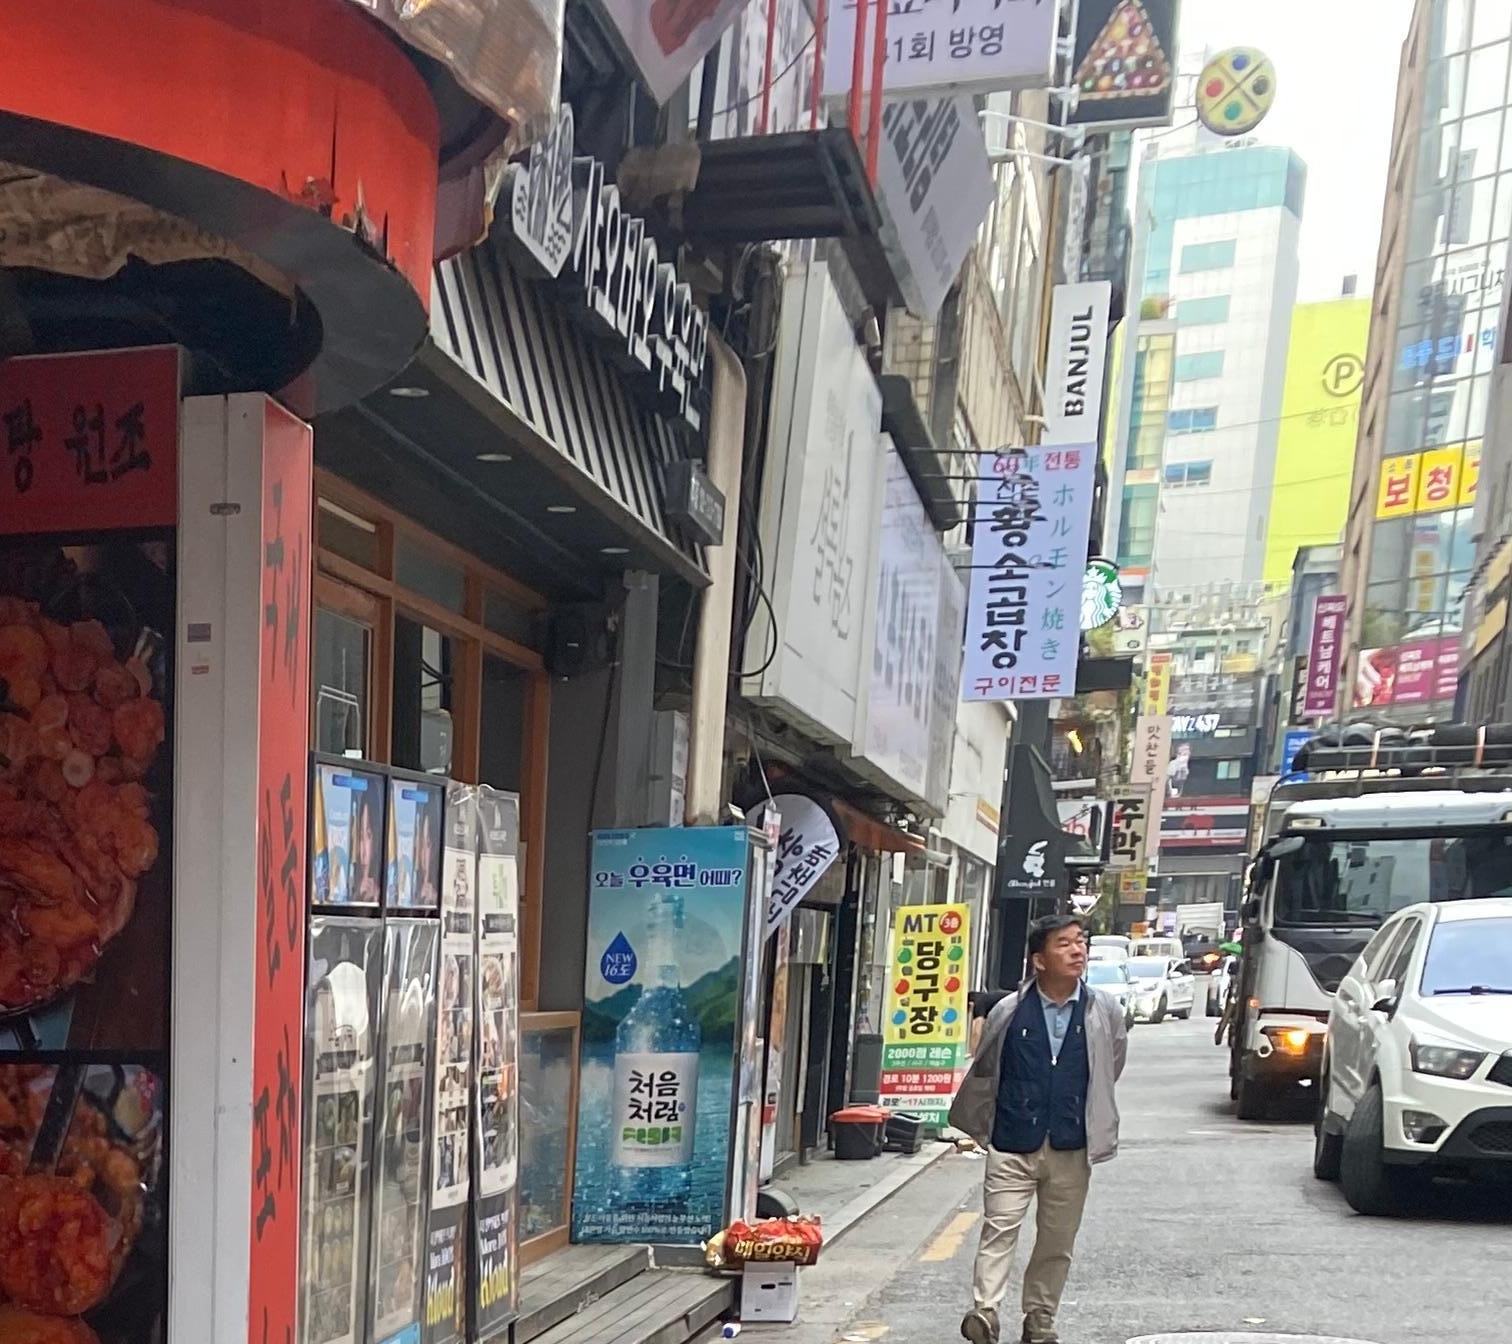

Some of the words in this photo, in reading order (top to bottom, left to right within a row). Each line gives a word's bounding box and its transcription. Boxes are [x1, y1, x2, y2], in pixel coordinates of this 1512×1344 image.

[884, 30, 936, 63] 1회
[948, 23, 1005, 60] 방영
[1063, 305, 1095, 418] BANJUL
[1333, 361, 1355, 390] P
[63, 401, 154, 486] 원조
[1044, 450, 1081, 472] 전통
[1040, 482, 1076, 662] ホルモン焼き
[980, 505, 1034, 671] 황소곱창
[973, 673, 1062, 697] 구이전문
[1112, 798, 1145, 862] 주막
[595, 871, 624, 888] 오늘
[627, 862, 697, 888] 우육면
[699, 869, 743, 887] 어때?
[903, 913, 938, 934] MT
[603, 963, 631, 977] 16도
[605, 953, 634, 964] NEW
[909, 940, 945, 1036] 당구장
[928, 1047, 952, 1060] 레슨
[628, 1069, 681, 1099] 처음
[628, 1098, 680, 1124] 처럼
